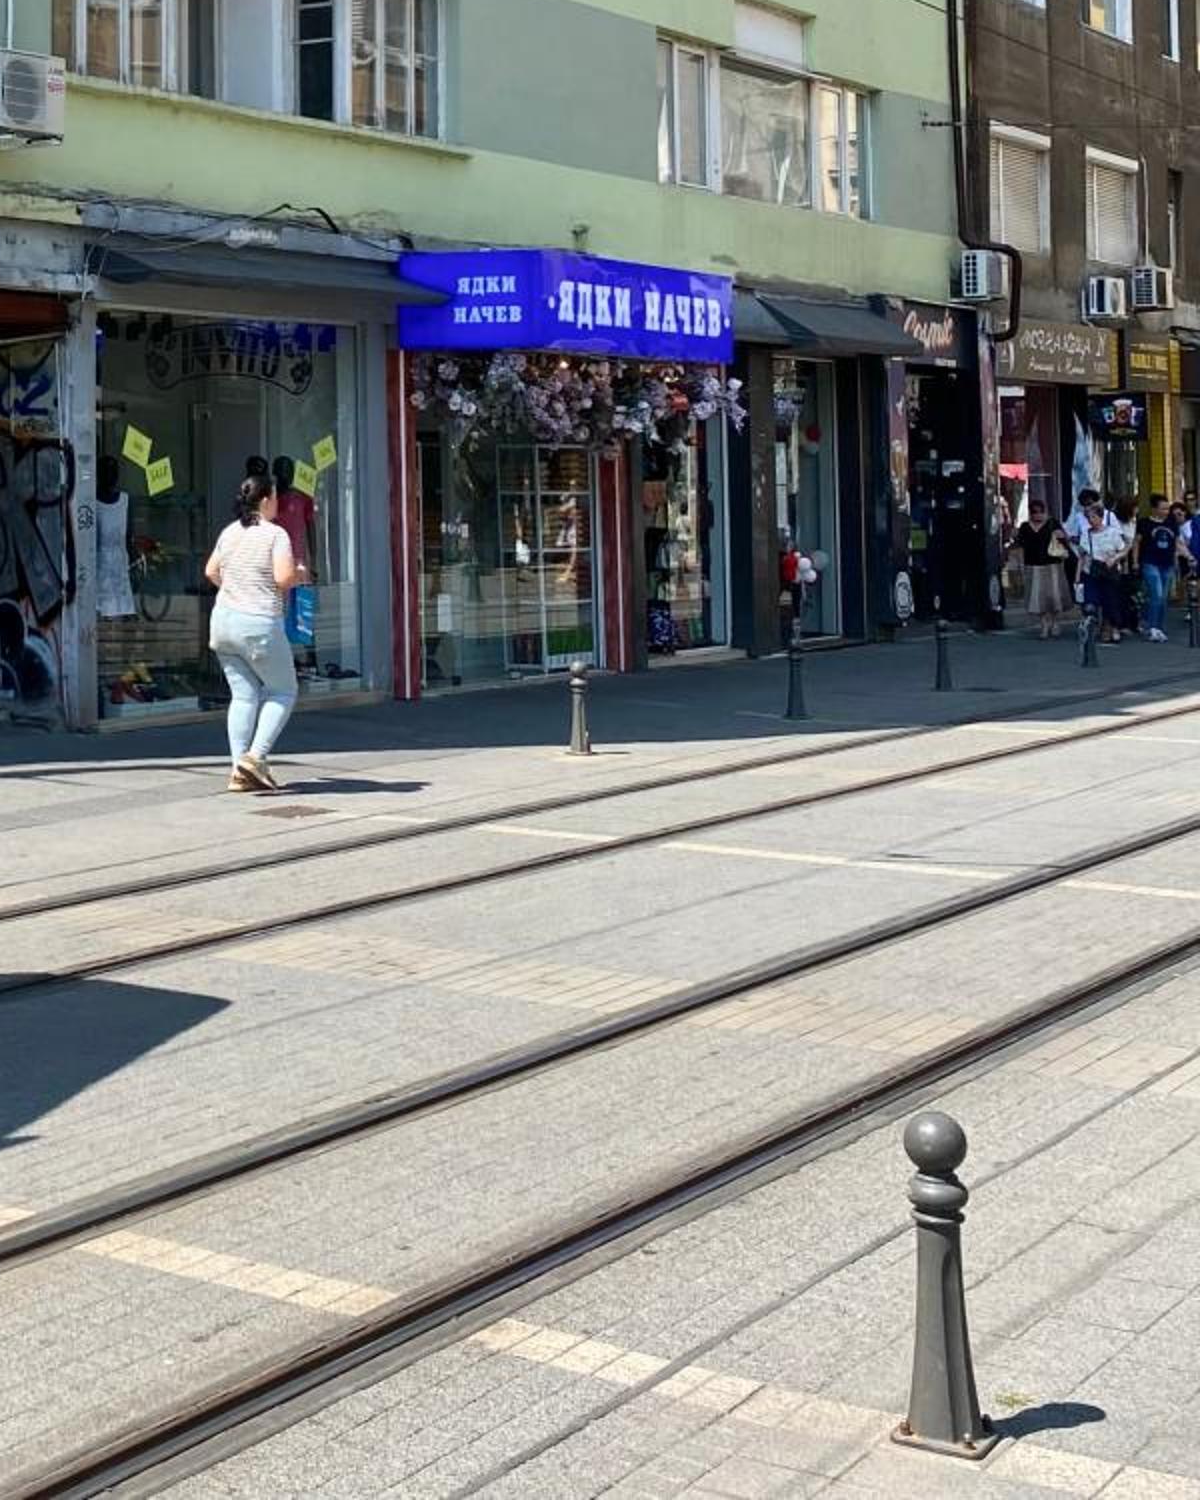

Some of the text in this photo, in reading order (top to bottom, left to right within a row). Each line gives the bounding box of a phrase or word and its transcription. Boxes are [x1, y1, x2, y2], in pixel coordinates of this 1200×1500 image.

[457, 275, 517, 297] ЯДКИ
[453, 304, 523, 324] НАЧЕВ
[557, 280, 722, 338] ЯДКИ НАЧЕВ
